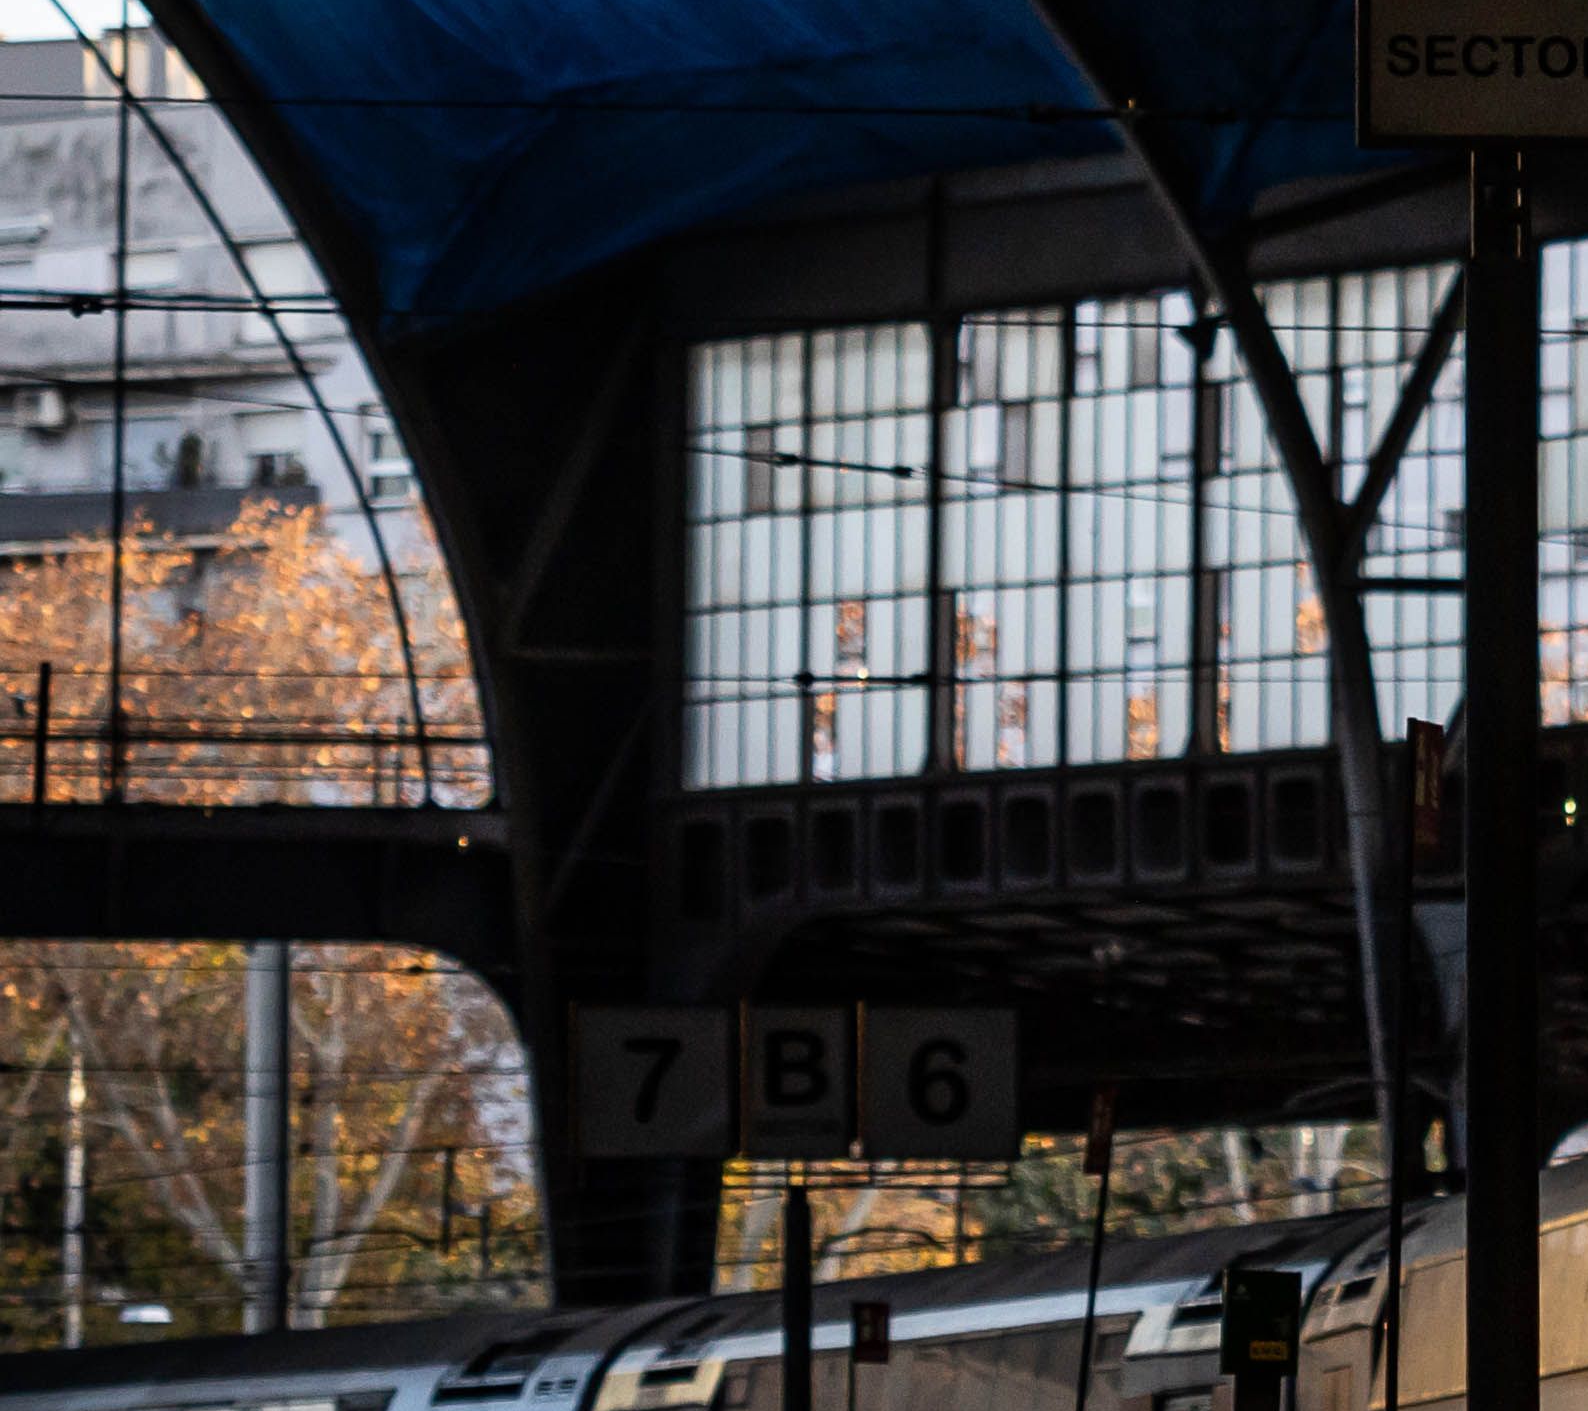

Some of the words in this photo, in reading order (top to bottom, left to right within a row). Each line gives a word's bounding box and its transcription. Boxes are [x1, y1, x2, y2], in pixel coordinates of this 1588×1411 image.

[623, 1037, 681, 1124] 7
[763, 1029, 830, 1106] B
[908, 1039, 970, 1124] 6
